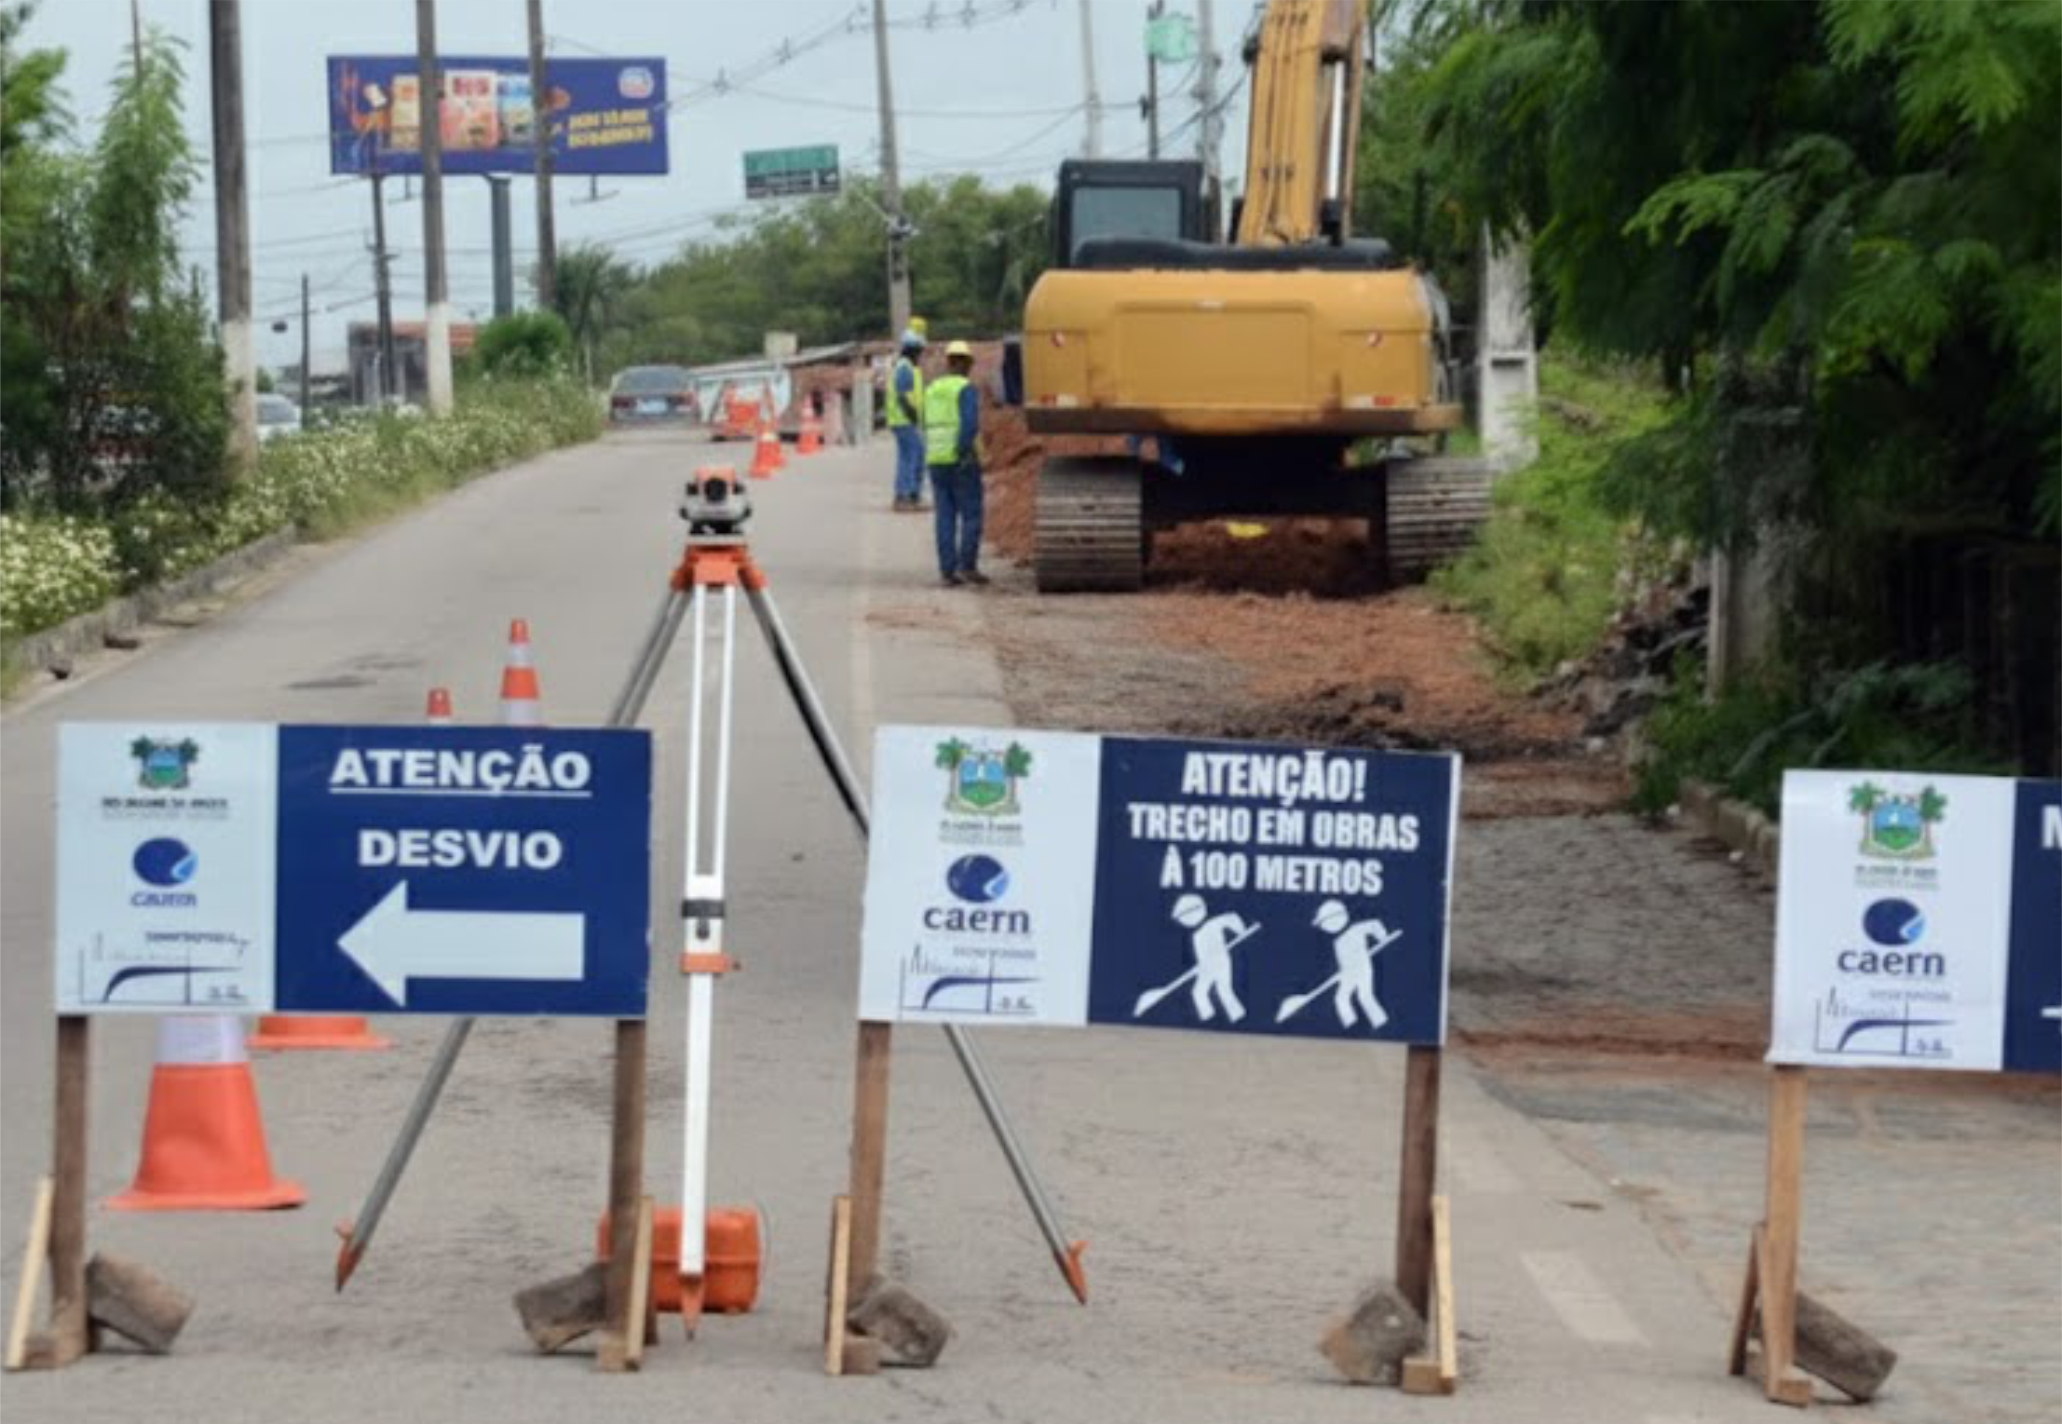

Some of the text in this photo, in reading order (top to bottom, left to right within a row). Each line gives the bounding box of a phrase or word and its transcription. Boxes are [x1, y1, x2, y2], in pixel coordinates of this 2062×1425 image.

[329, 744, 591, 797] ATENÇÃO
[1181, 750, 1367, 806] ATENÇÃO!
[357, 829, 562, 869] DESVIO
[1128, 802, 1420, 852] TRECHO EM OBRAS
[1160, 844, 1383, 896] À 100 METROS
[923, 905, 1031, 934] caern
[1837, 950, 1946, 976] caern
